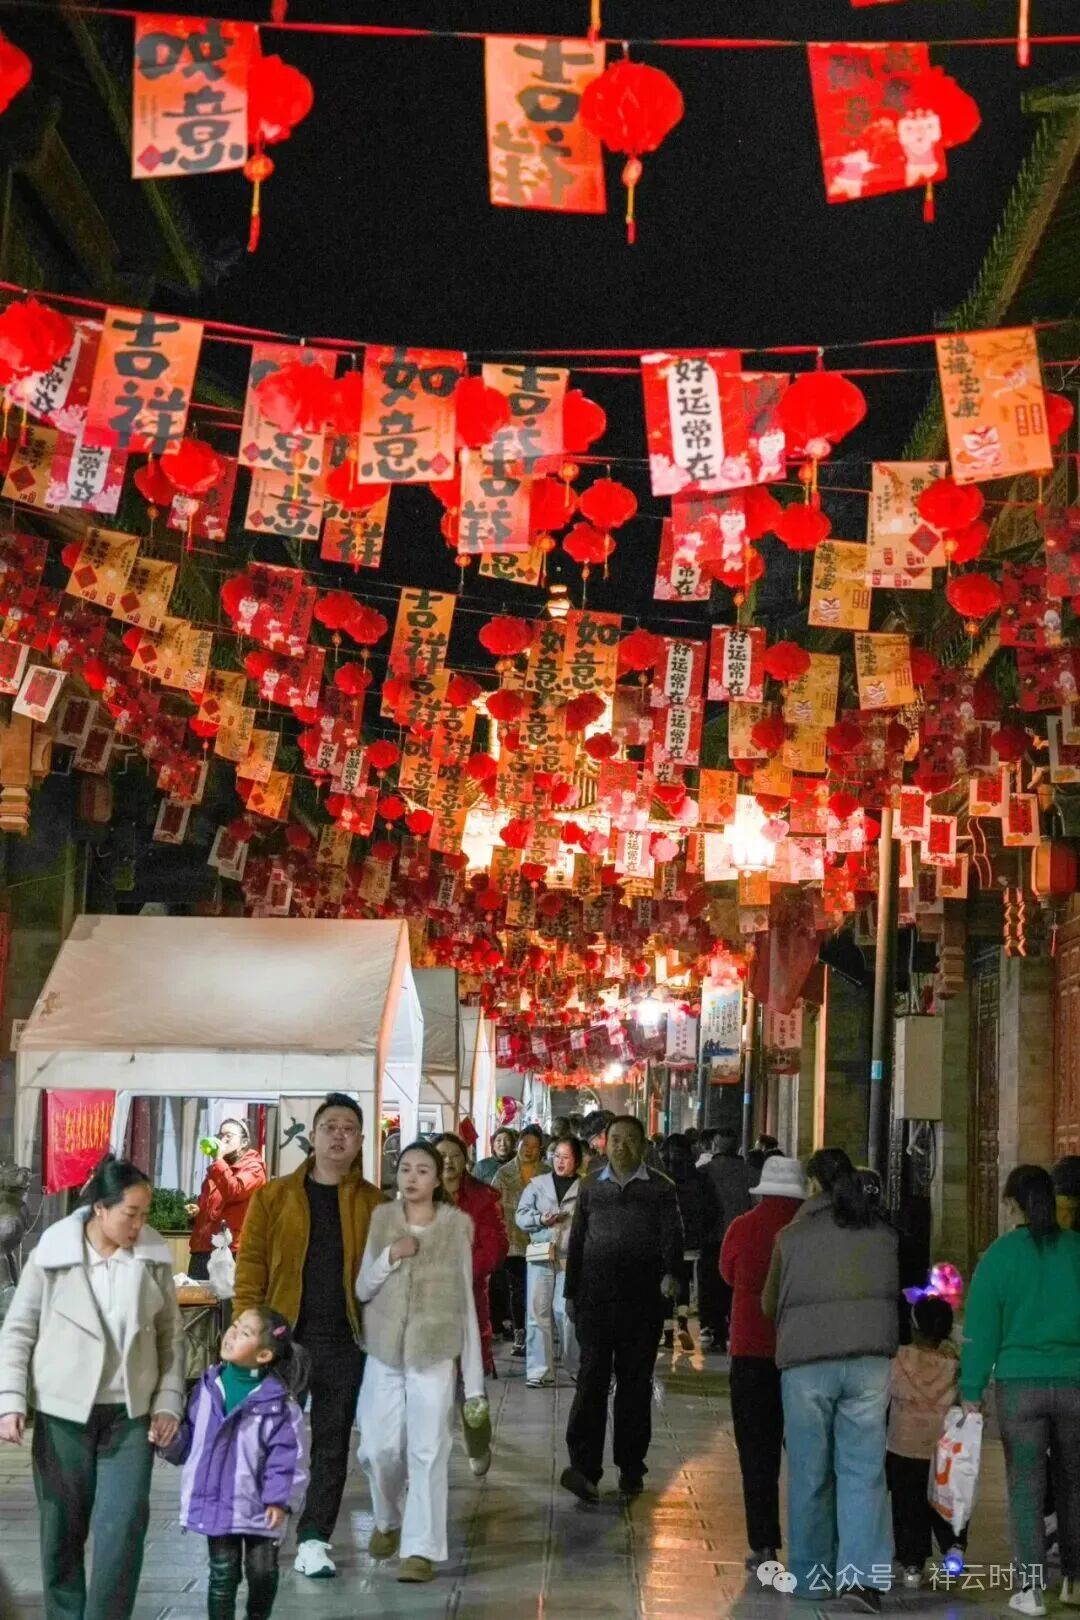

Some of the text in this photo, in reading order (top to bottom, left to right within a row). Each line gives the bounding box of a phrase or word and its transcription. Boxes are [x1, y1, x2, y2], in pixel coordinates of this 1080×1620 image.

[110, 312, 187, 453] 吉祥
[361, 346, 461, 480] 如意
[674, 357, 717, 481] 好运常在
[405, 588, 447, 674] 吉祥
[562, 614, 620, 691] 如意
[728, 631, 748, 697] 好运常在
[669, 643, 691, 706] 好运常在
[669, 707, 688, 760] 运常在
